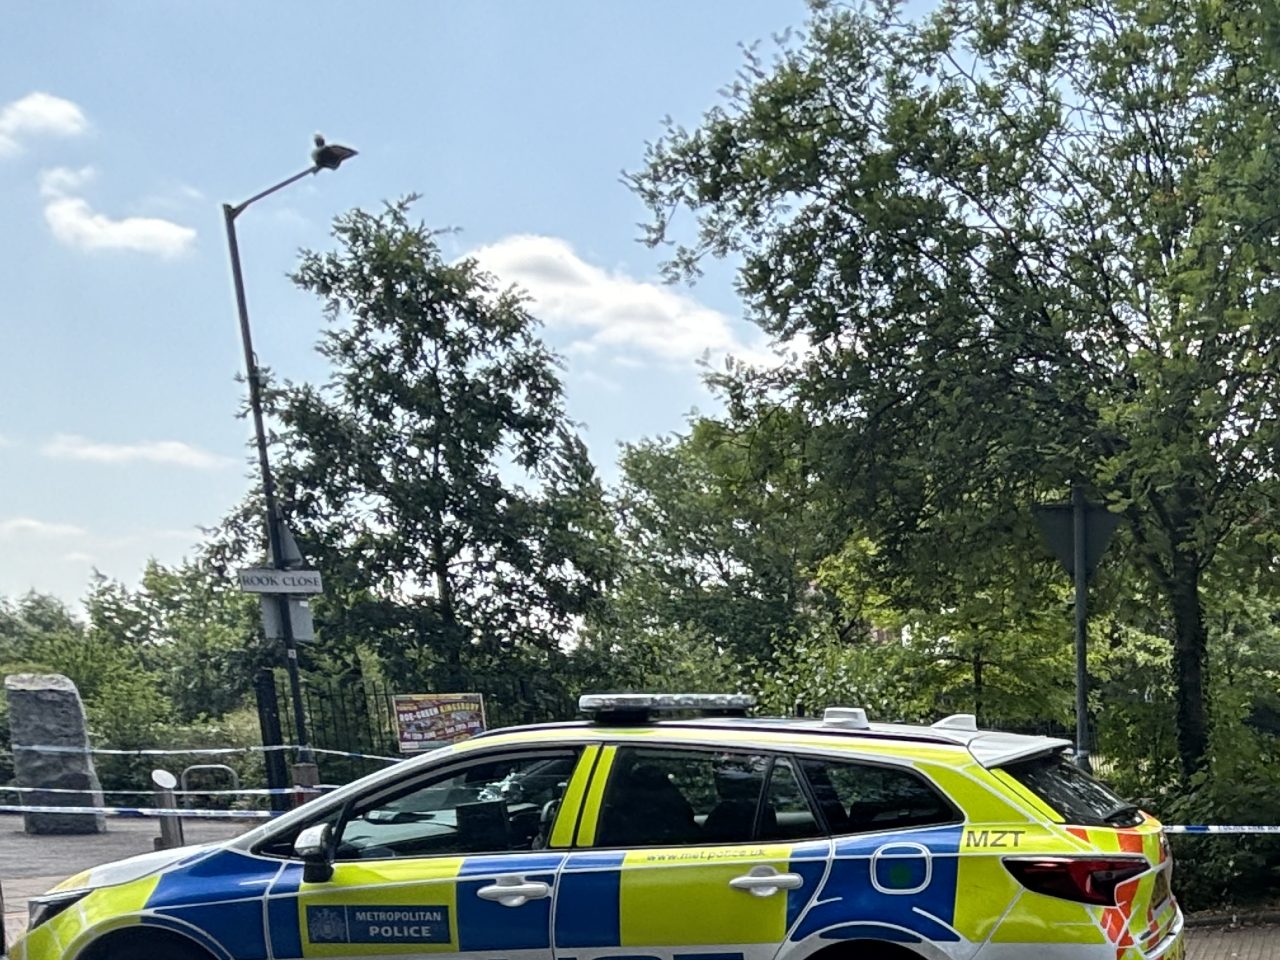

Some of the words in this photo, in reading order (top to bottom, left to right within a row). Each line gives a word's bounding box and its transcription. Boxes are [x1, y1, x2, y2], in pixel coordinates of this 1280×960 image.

[242, 575, 279, 586] ROOK
[283, 576, 320, 586] CLOSE
[440, 702, 479, 713] KINGSBURY
[965, 830, 1026, 848] MZT
[355, 911, 442, 922] METROPOLITAN
[368, 925, 432, 938] POLICE
